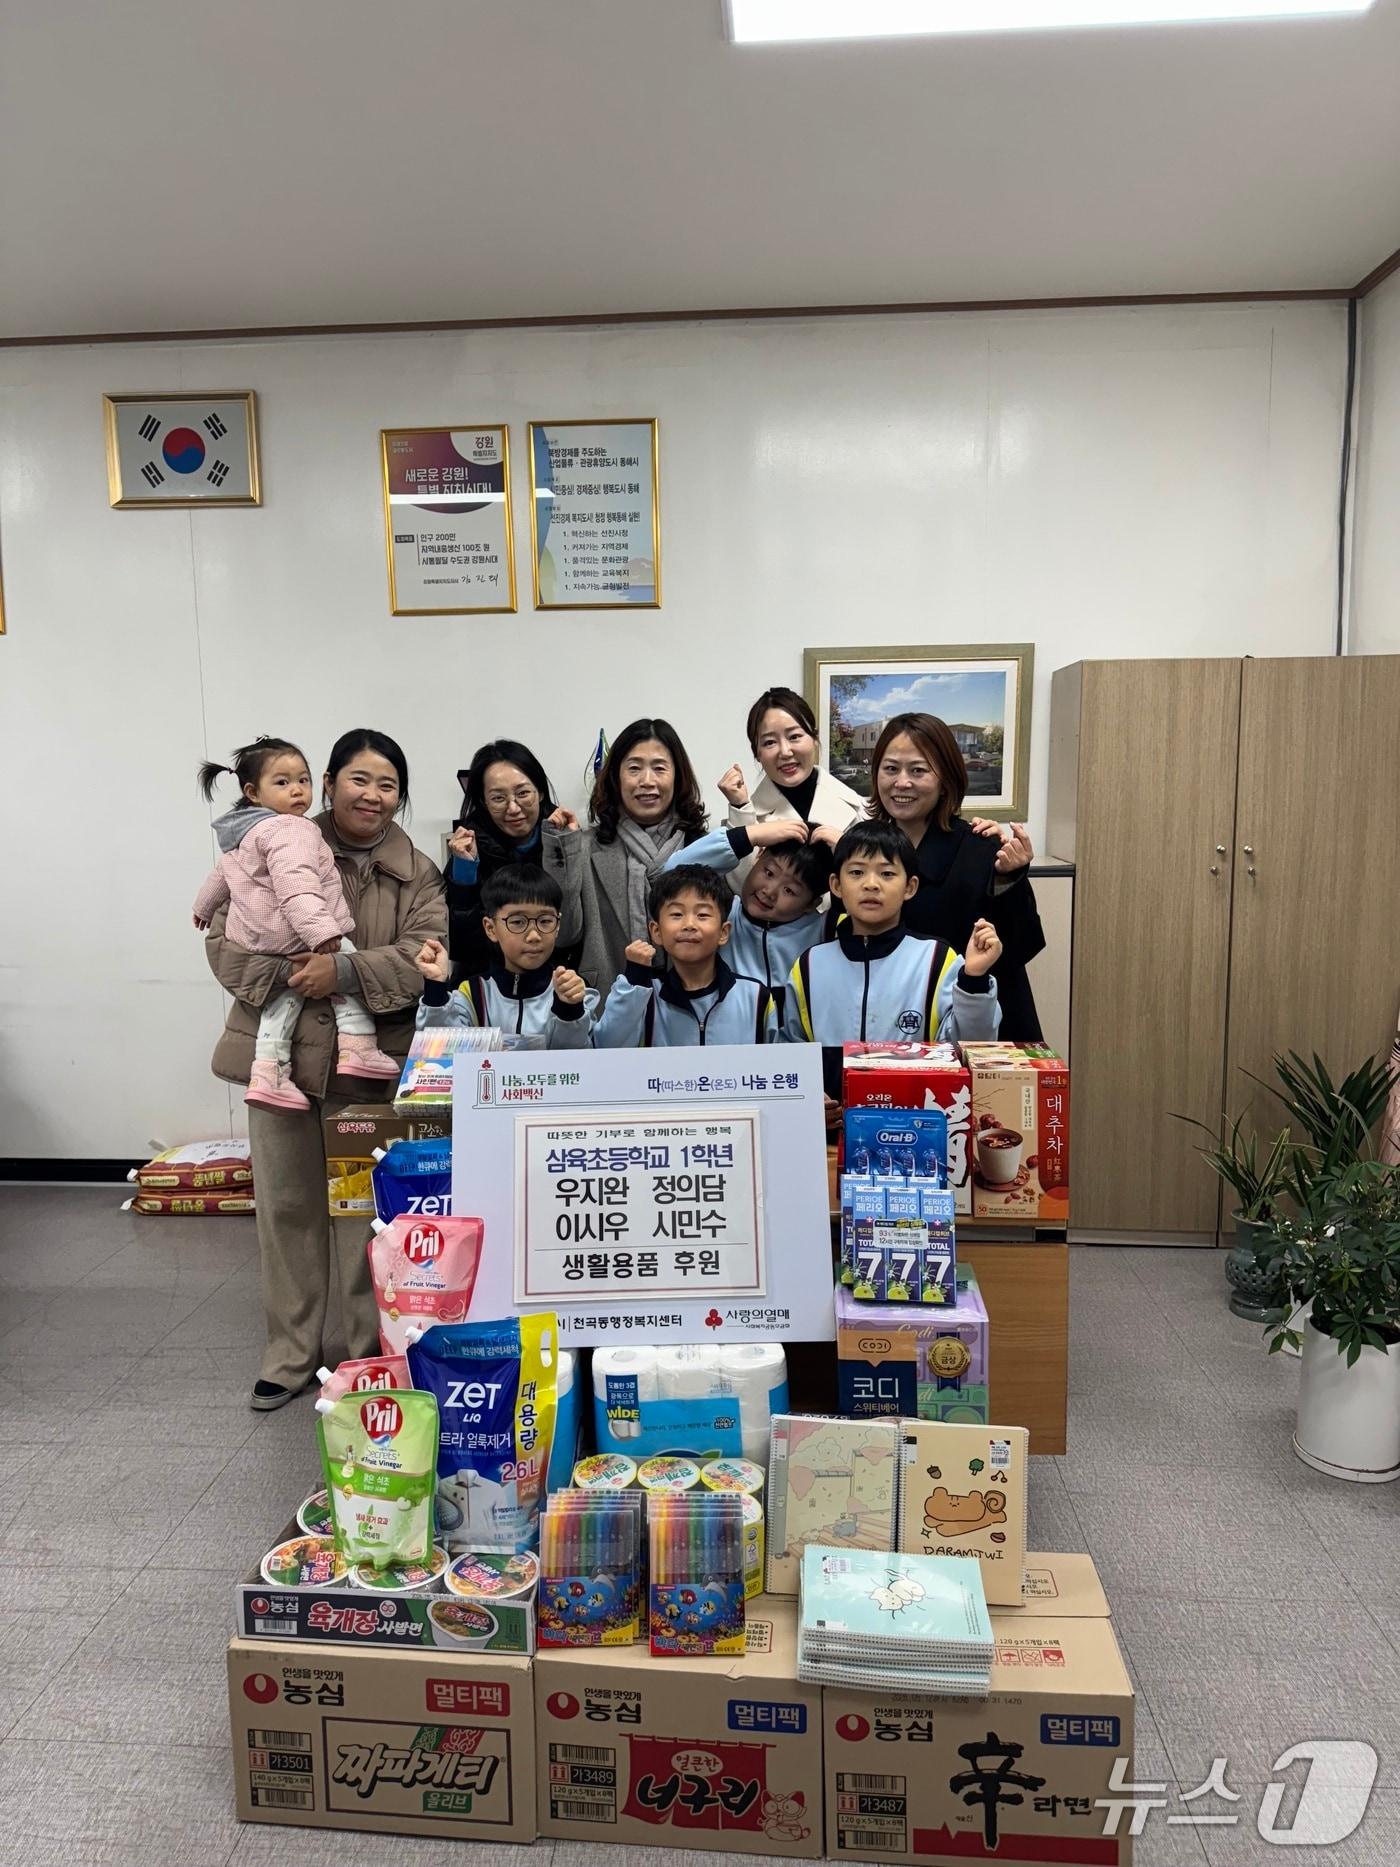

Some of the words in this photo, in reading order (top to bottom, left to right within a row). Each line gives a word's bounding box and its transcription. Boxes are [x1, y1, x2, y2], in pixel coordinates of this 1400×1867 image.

[476, 436, 494, 449] 강원
[581, 448, 607, 456] 주도하는
[620, 457, 639, 466] 동해시
[406, 468, 439, 482] 새로운
[442, 467, 469, 481] 강원!
[628, 483, 640, 494] 동해
[421, 534, 433, 542] 인구
[436, 533, 456, 541] 200만
[462, 544, 481, 552] 100조
[450, 556, 470, 564] 수도권
[472, 555, 498, 564] 강원시대
[560, 1073, 580, 1085] 위한
[742, 1074, 768, 1090] 나눔
[772, 1073, 799, 1089] 은행
[502, 1088, 544, 1100] 사회백신
[866, 1094, 892, 1102] 오리온
[337, 1121, 376, 1133] 삼육두유
[1045, 1094, 1064, 1155] 대추차
[547, 1130, 587, 1140] 따뜻한
[596, 1129, 635, 1138] 기부로
[644, 1127, 697, 1137] 함께하는
[706, 1126, 732, 1135] 행복
[880, 1133, 913, 1142] Oral-B
[545, 1145, 670, 1173] 삼육초등학교
[680, 1144, 734, 1168] 1학년
[555, 1176, 630, 1207] 우지완
[651, 1174, 727, 1203] 정의담
[856, 1203, 883, 1212] 페리오
[890, 1204, 917, 1213] 페리오
[924, 1205, 951, 1215] 페리오
[556, 1212, 630, 1242] 이시우
[652, 1210, 727, 1240] 시민수
[409, 1230, 440, 1258] Pril
[562, 1252, 658, 1280] 생활용품
[673, 1250, 721, 1276] 후원
[858, 1252, 882, 1283] 7
[892, 1253, 916, 1284] 7
[927, 1255, 951, 1285] 7
[573, 1314, 682, 1330] 천곡동행정복지센터
[726, 1308, 790, 1323] 사랑의열매
[487, 1344, 519, 1356] 강력세척
[942, 1356, 956, 1365] 금상
[357, 1371, 391, 1392] Pril
[853, 1377, 899, 1398] 코디
[854, 1403, 899, 1412] 스위티베어
[366, 1402, 397, 1432] Pril
[519, 1381, 538, 1451] 대용량
[439, 1432, 464, 1447] 트라
[467, 1432, 511, 1450] 얼룩제거
[379, 1460, 402, 1469] Vinegar
[270, 1602, 299, 1614] 농심
[443, 1605, 490, 1625] 육개장
[307, 1601, 379, 1633] 육개장
[376, 1620, 424, 1637] 사발면
[282, 1667, 311, 1678] 인생을
[313, 1668, 344, 1682] 맛있게
[283, 1680, 344, 1706] 농심
[433, 1684, 502, 1712] 멀티팩
[584, 1688, 612, 1698] 인생을
[613, 1690, 641, 1701] 맛있게
[584, 1699, 642, 1724] 농심
[734, 1704, 800, 1729] 멀티팩
[873, 1708, 903, 1718] 인생을
[904, 1709, 934, 1720] 맛있게
[873, 1719, 934, 1742] 농심
[1047, 1718, 1113, 1743] 멀티팩
[271, 1755, 310, 1770] 가3501
[333, 1744, 500, 1797] 짜파게티
[676, 1754, 720, 1772] 얼큰한
[573, 1768, 614, 1784] 가3489
[426, 1792, 467, 1810] 올리브
[636, 1773, 759, 1816] 너구리
[860, 1797, 904, 1812] 가3487
[1033, 1795, 1092, 1817] 라면
